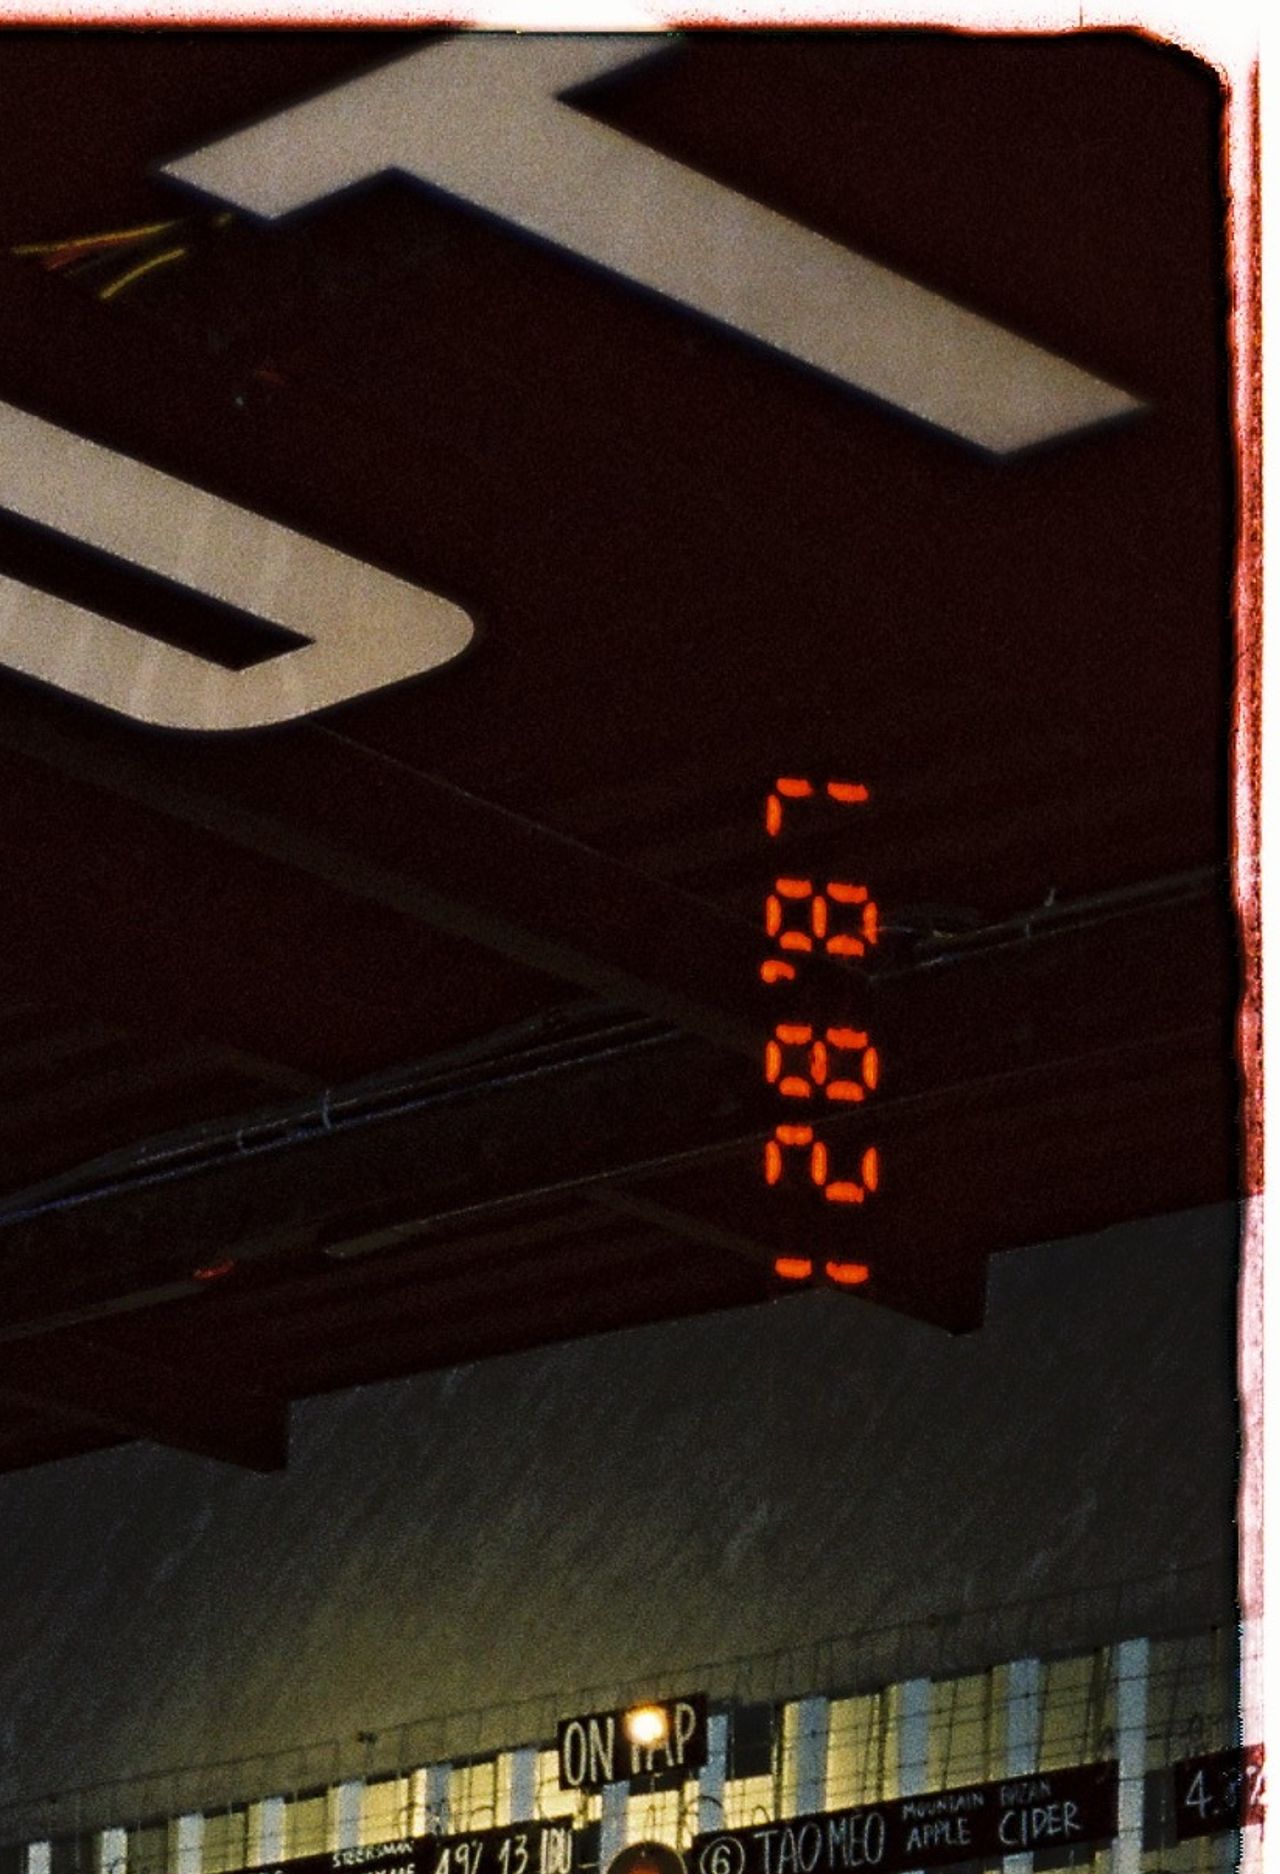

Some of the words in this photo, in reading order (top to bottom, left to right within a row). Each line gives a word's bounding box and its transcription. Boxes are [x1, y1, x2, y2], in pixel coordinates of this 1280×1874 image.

[564, 1717, 614, 1785] ON
[906, 1816, 972, 1850] APPLE
[999, 1800, 1081, 1846] CIDER
